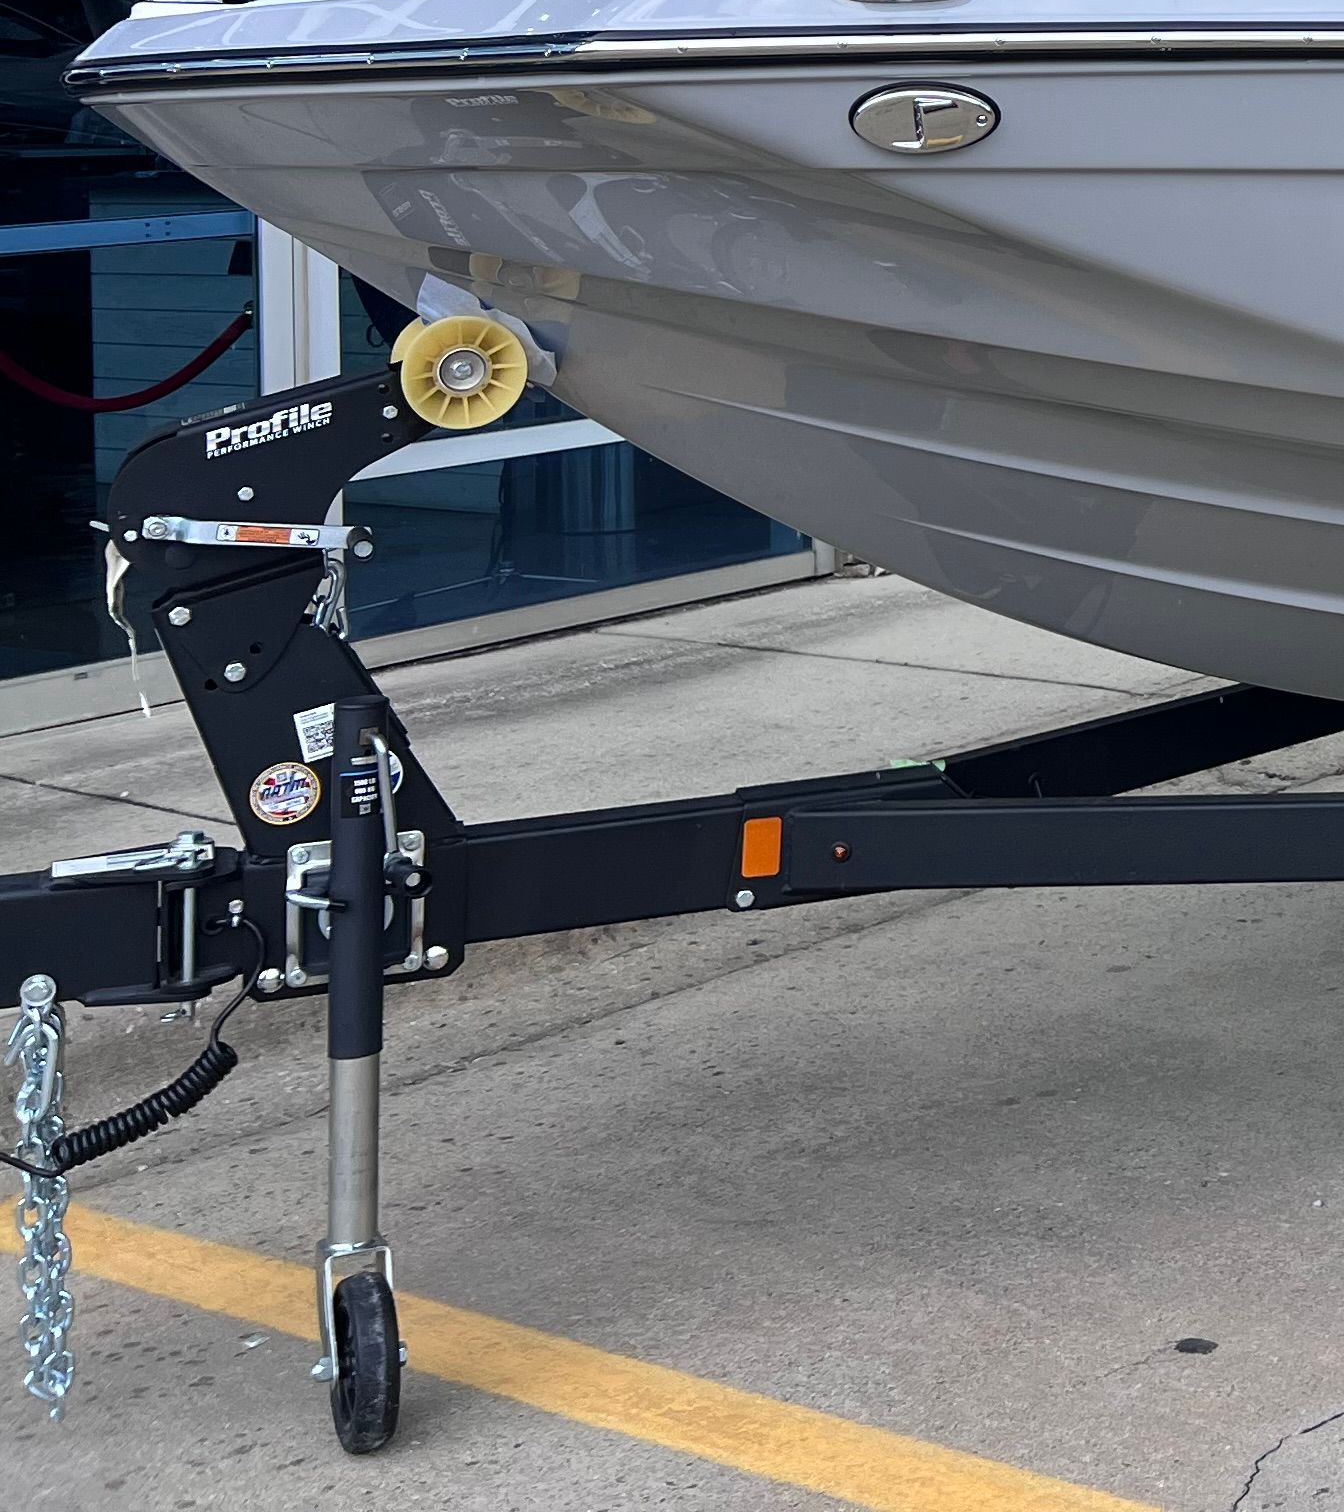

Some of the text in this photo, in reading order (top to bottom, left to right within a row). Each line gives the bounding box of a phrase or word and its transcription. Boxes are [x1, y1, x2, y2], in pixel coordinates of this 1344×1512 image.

[206, 401, 334, 452] Profile
[206, 417, 332, 460] PERFORMANCE WINCH
